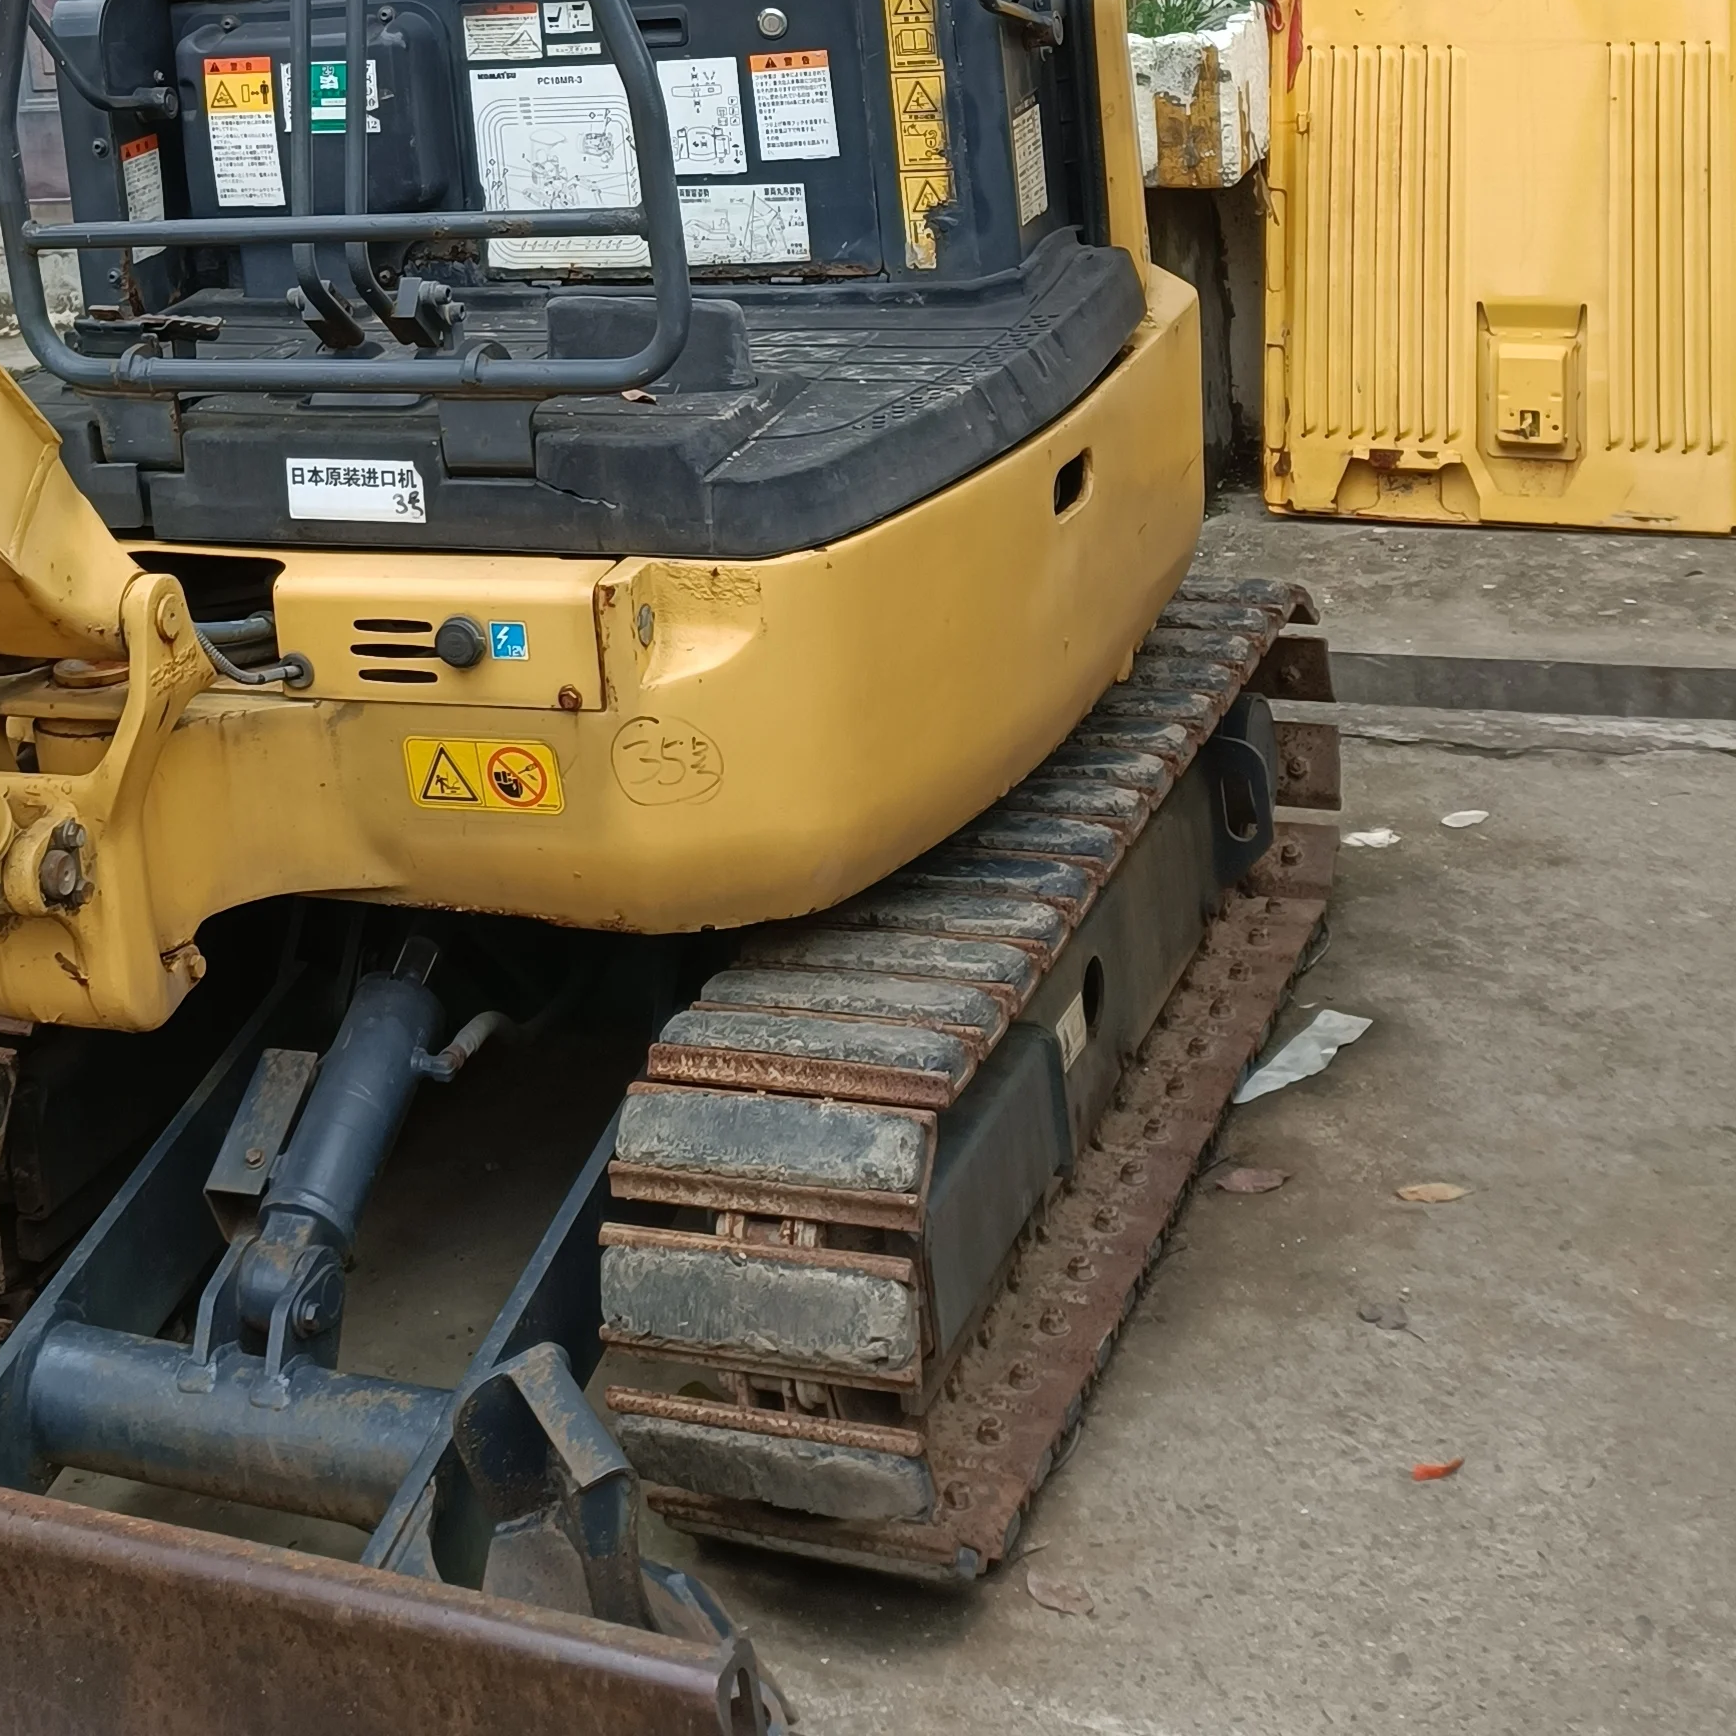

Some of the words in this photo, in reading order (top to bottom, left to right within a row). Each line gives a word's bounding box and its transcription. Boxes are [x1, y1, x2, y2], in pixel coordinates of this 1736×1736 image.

[291, 466, 418, 489] 日本原装进口机
[507, 644, 526, 657] 12V
